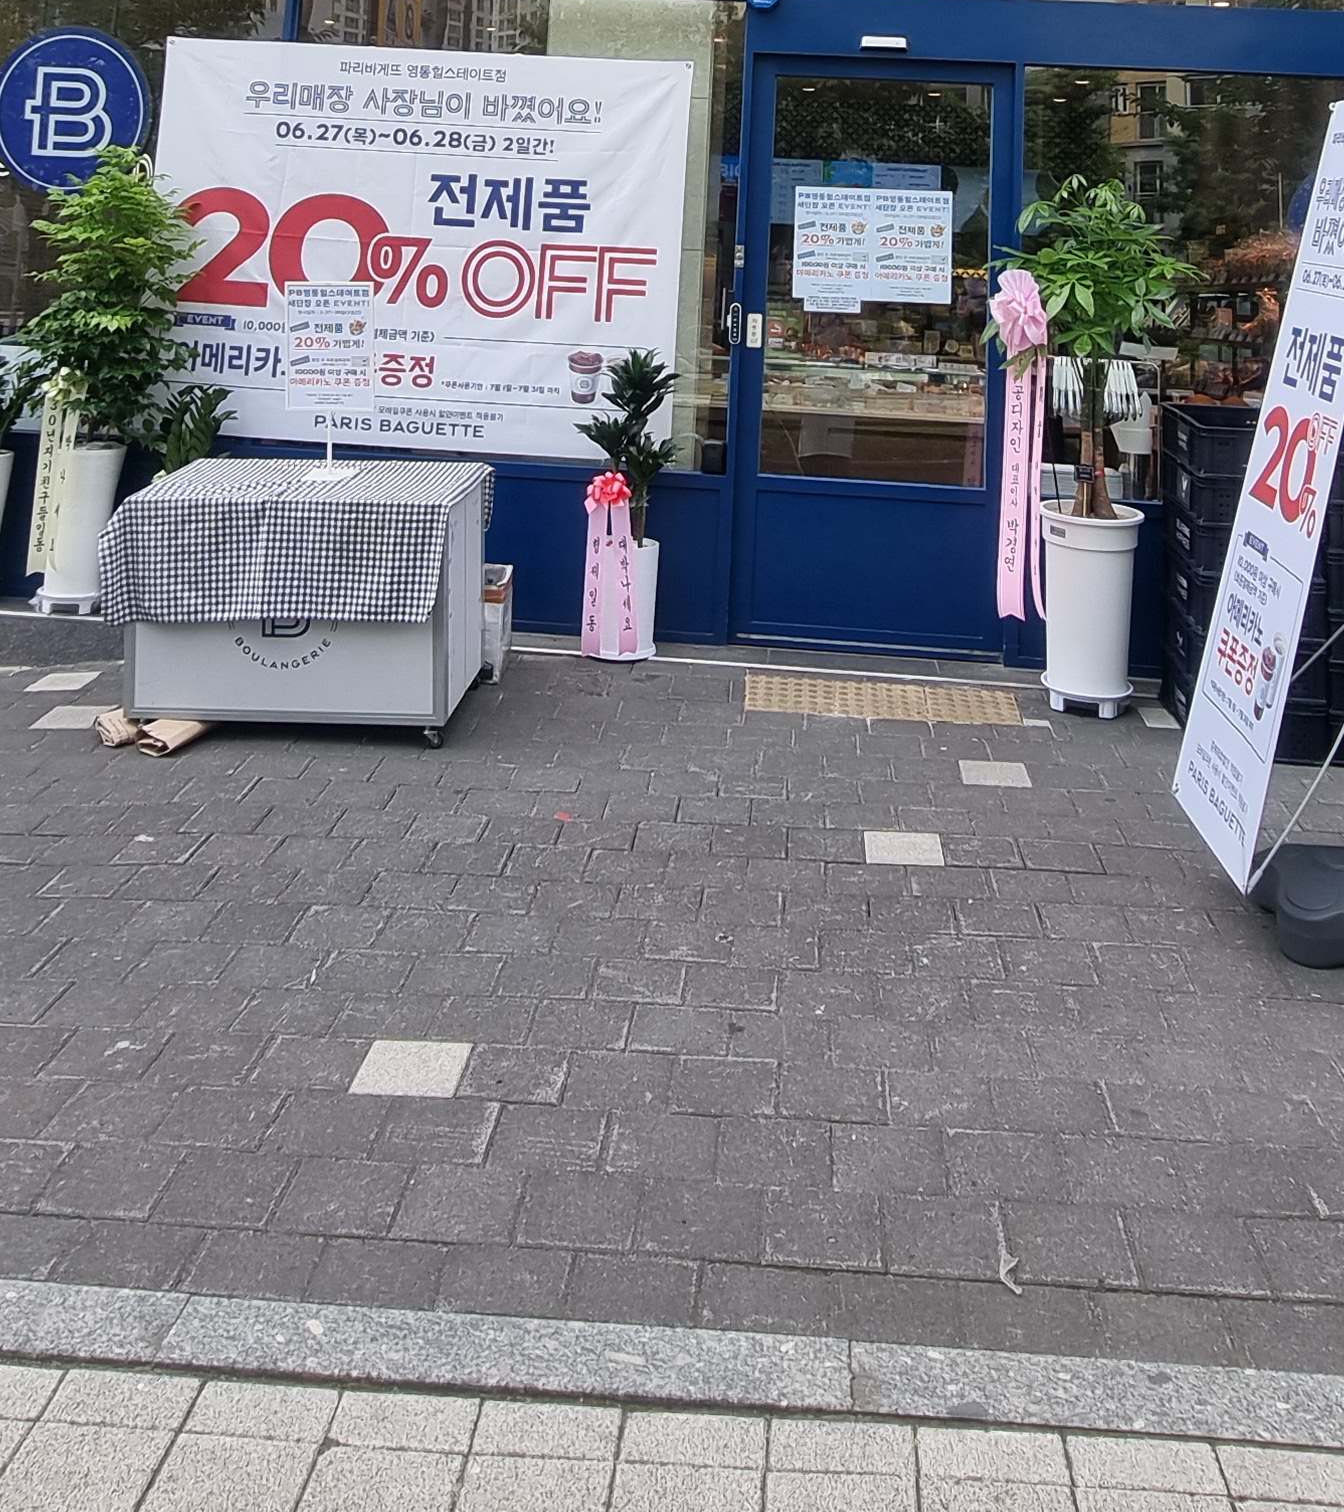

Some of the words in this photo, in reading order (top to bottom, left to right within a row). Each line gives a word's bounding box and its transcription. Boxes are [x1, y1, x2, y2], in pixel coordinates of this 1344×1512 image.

[339, 61, 402, 76] 파리바게뜨
[406, 64, 507, 82] 영통힐스테이트점
[245, 81, 354, 114] 우리매장
[362, 88, 472, 120] 사장님이
[502, 136, 555, 155] 2일간!
[427, 171, 591, 234] 전제품
[801, 234, 834, 245] 20%
[880, 237, 913, 248] 20%
[177, 186, 449, 310] 20%
[461, 239, 658, 324] OFF
[186, 315, 225, 326] EVENT
[294, 337, 331, 349] 20%
[314, 415, 372, 432] PARIS
[379, 419, 486, 439] BAGUETTE
[234, 636, 331, 670] BOULANGERIE
[1188, 760, 1209, 795] PARIS
[1208, 788, 1246, 848] BAGUETTE
